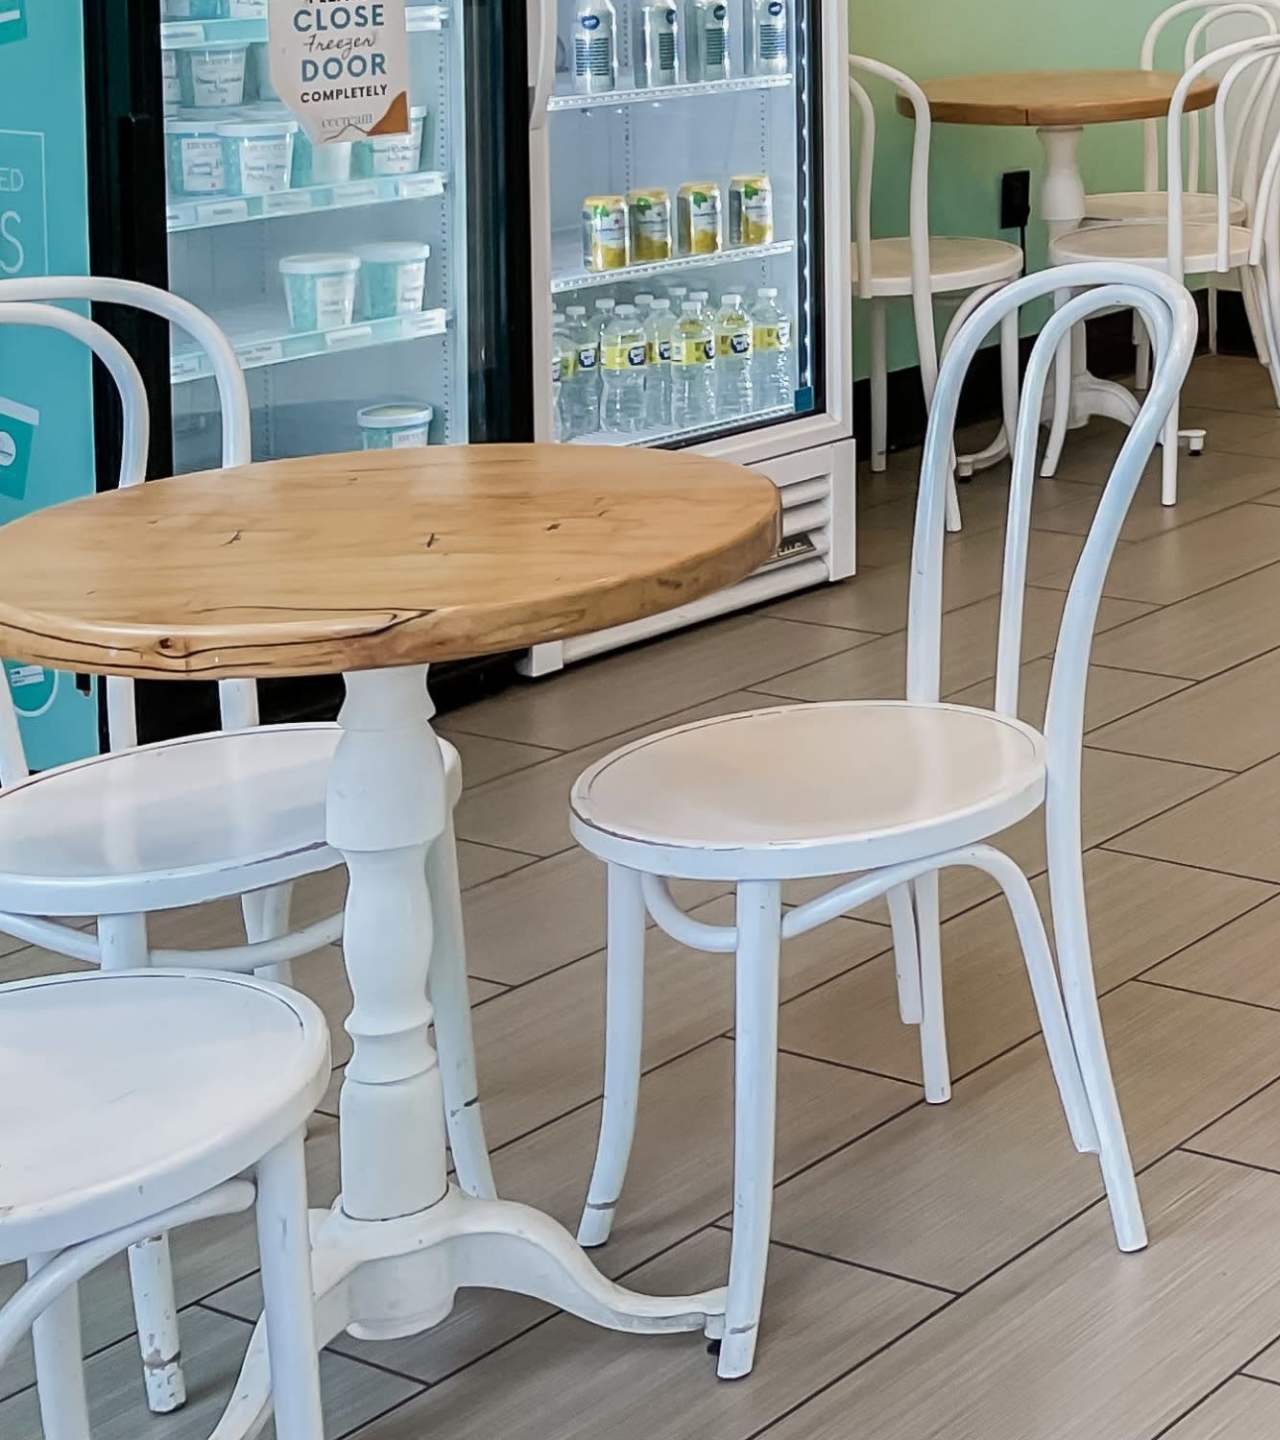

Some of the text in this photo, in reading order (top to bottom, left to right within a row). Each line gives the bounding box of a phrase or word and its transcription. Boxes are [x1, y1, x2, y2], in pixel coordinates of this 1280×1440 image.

[293, 5, 384, 32] CLOSE
[303, 34, 375, 60] Freezer
[302, 53, 386, 82] DOOR
[301, 84, 388, 103] COMPLETELY
